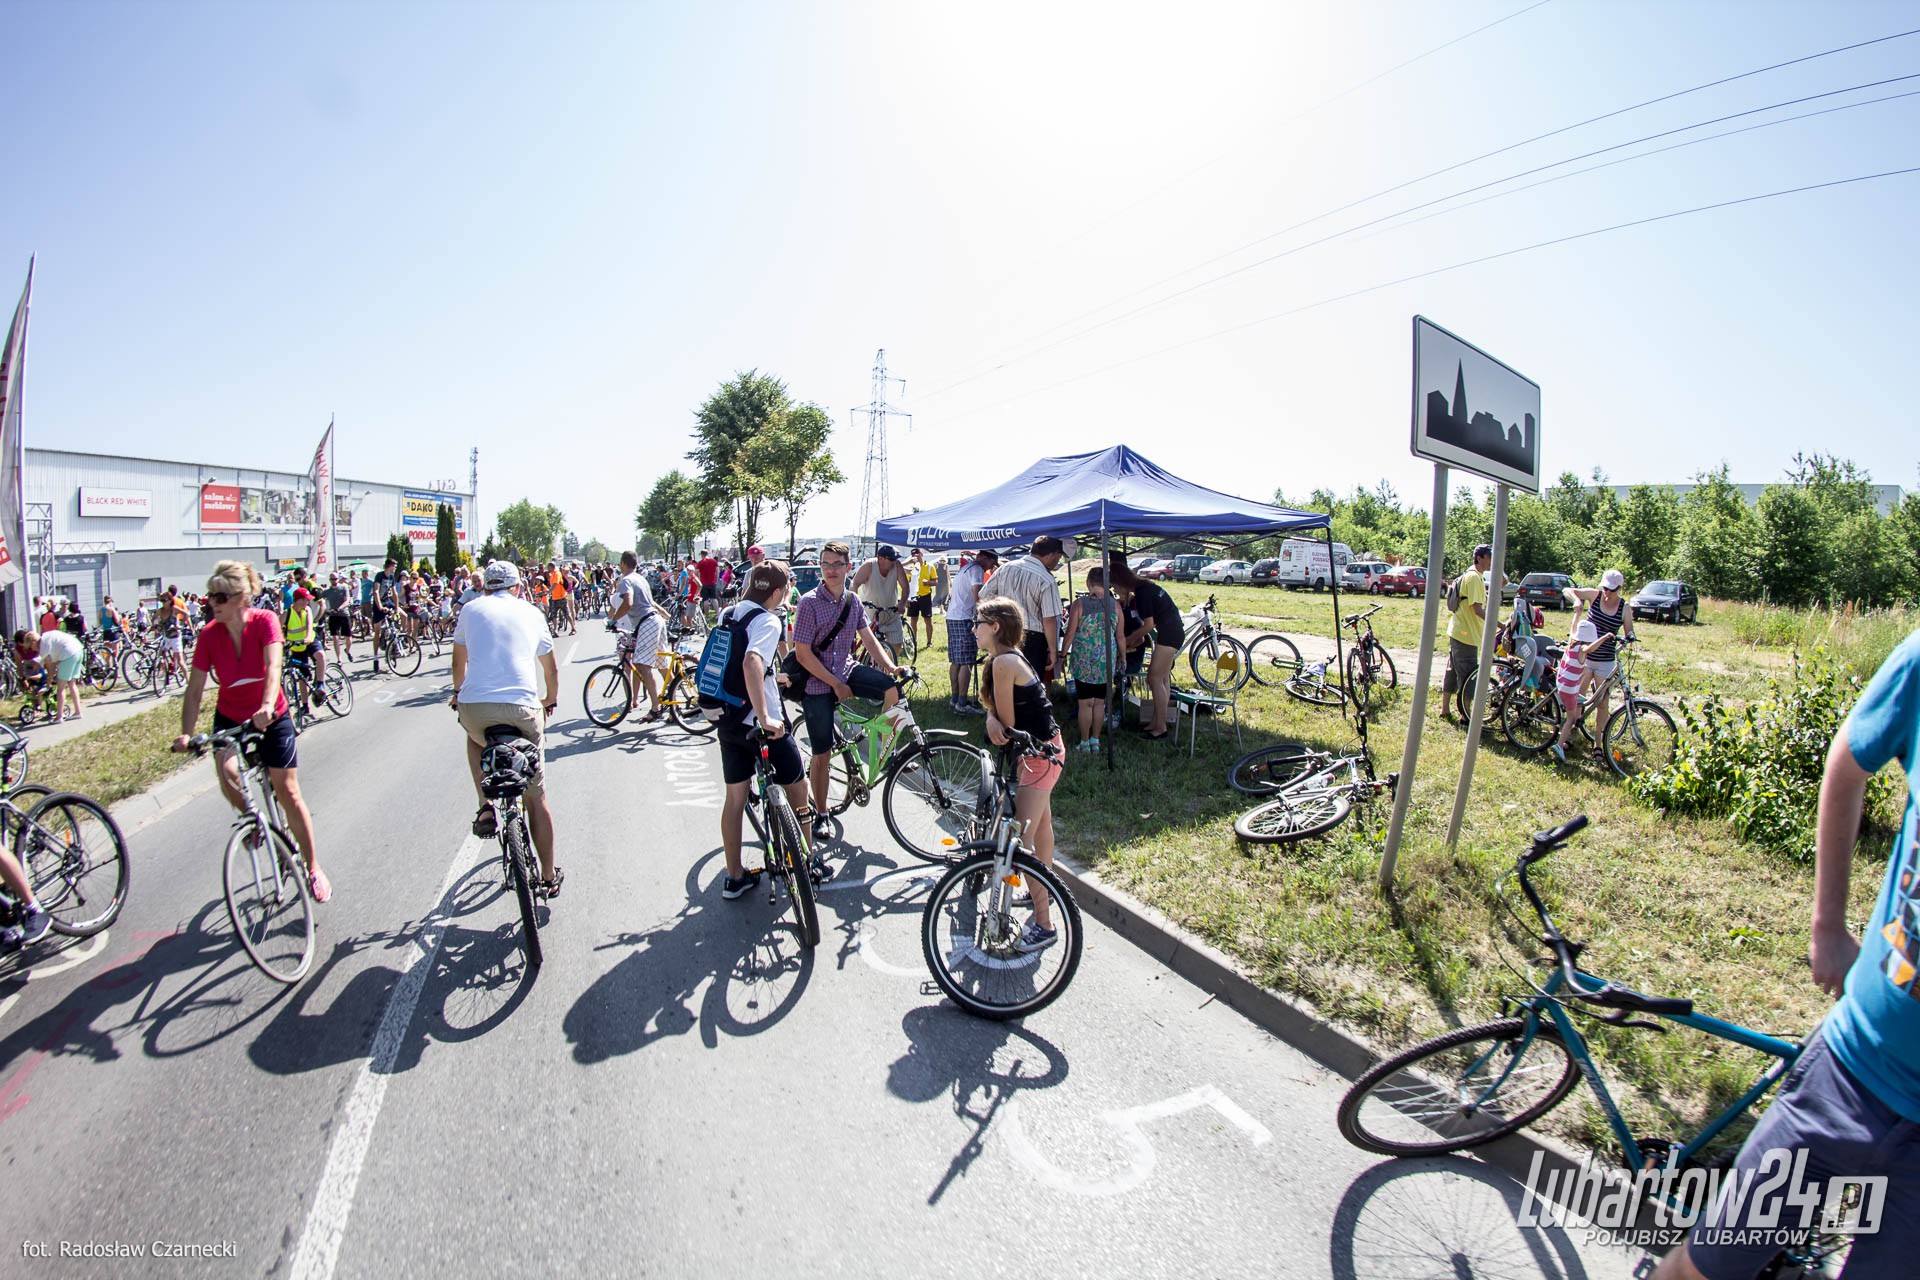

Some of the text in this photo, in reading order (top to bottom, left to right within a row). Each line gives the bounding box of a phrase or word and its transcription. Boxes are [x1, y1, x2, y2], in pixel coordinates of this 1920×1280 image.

[86, 496, 147, 506] BLACK RED WHITE
[410, 501, 434, 513] DAKO
